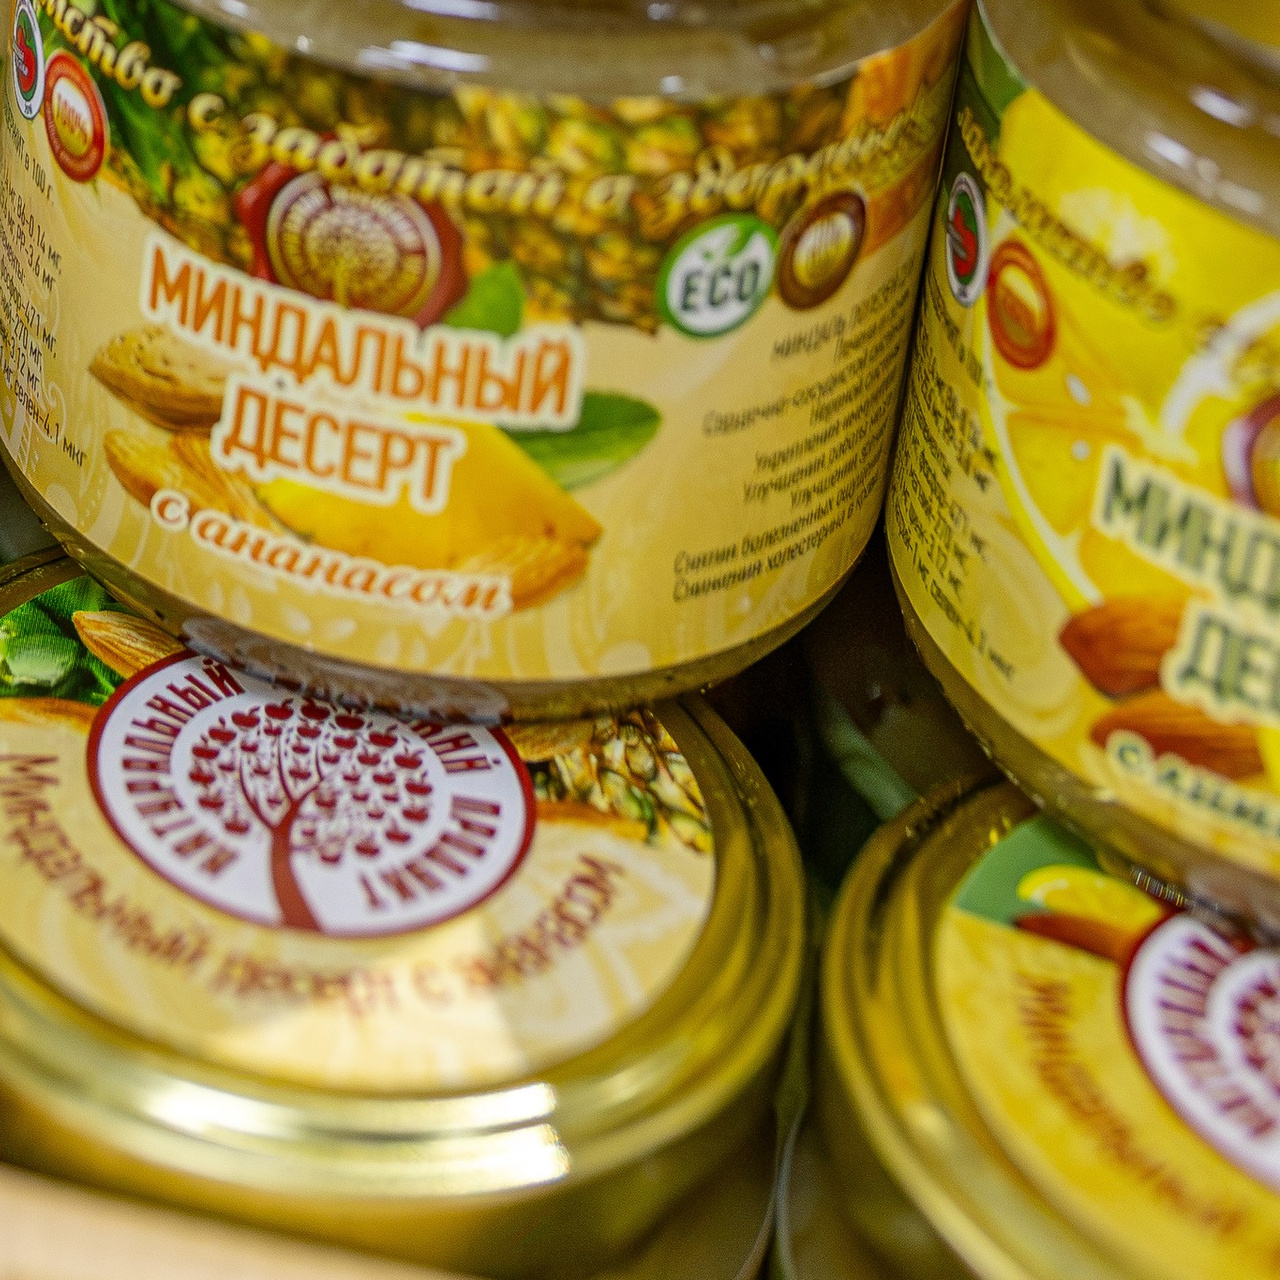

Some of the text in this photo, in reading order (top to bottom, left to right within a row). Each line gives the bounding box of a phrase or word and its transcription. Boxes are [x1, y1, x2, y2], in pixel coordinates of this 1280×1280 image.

[147, 249, 576, 421] МИНДАЛЬНЫЙ
[679, 261, 761, 313] ECO
[221, 390, 454, 507] ДЕСЕРТ
[196, 508, 513, 616] ананасом
